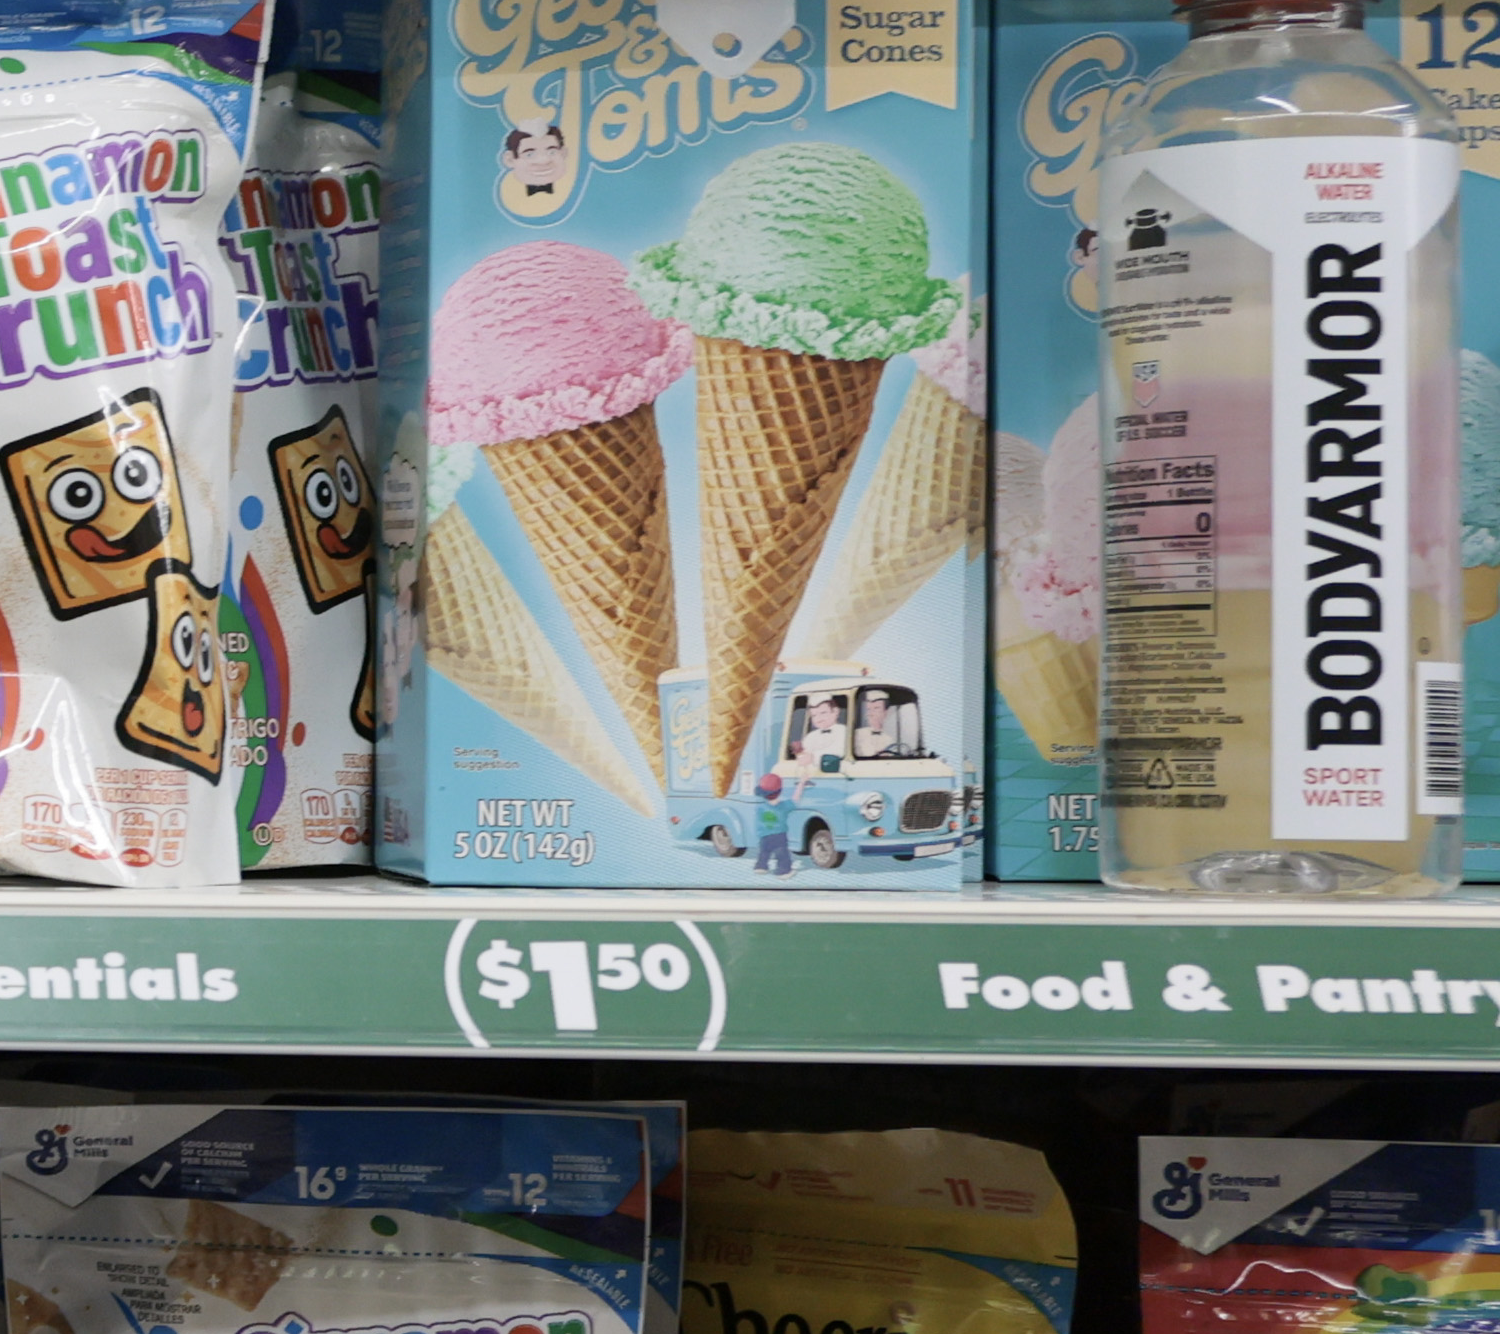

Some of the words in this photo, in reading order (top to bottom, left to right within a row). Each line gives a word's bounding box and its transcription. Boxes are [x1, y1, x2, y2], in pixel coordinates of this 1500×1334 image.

[839, 5, 945, 35] Sugar
[841, 39, 943, 64] Cones
[1304, 162, 1384, 181] ALKALINE
[1315, 183, 1374, 201] WATER
[1306, 241, 1382, 752] BODYARMOR
[453, 746, 500, 760] Serving
[1303, 767, 1383, 788] SPORT
[1303, 788, 1384, 809] WATER
[476, 800, 520, 828] NET
[529, 800, 574, 828] WT
[453, 835, 471, 859] 5
[476, 834, 510, 859] OZ
[512, 830, 596, 866] (142g)
[938, 960, 1134, 1013] Food
[1161, 962, 1233, 1013] &
